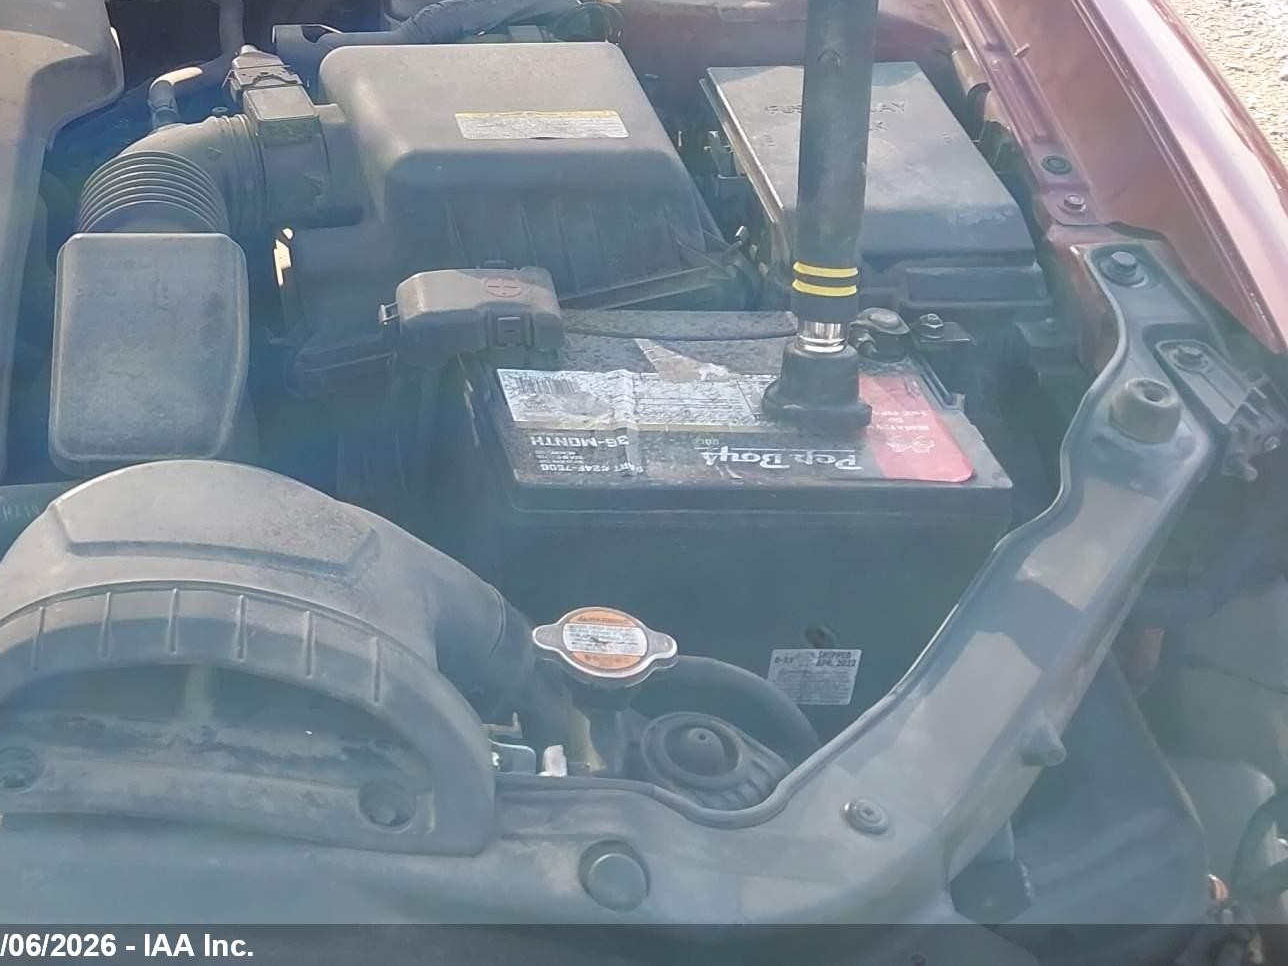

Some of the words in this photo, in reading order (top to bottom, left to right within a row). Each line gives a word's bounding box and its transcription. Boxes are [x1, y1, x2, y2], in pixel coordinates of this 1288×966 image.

[529, 435, 630, 448] 36-MONTH
[700, 446, 790, 470] Boys
[791, 450, 863, 470] Pep
